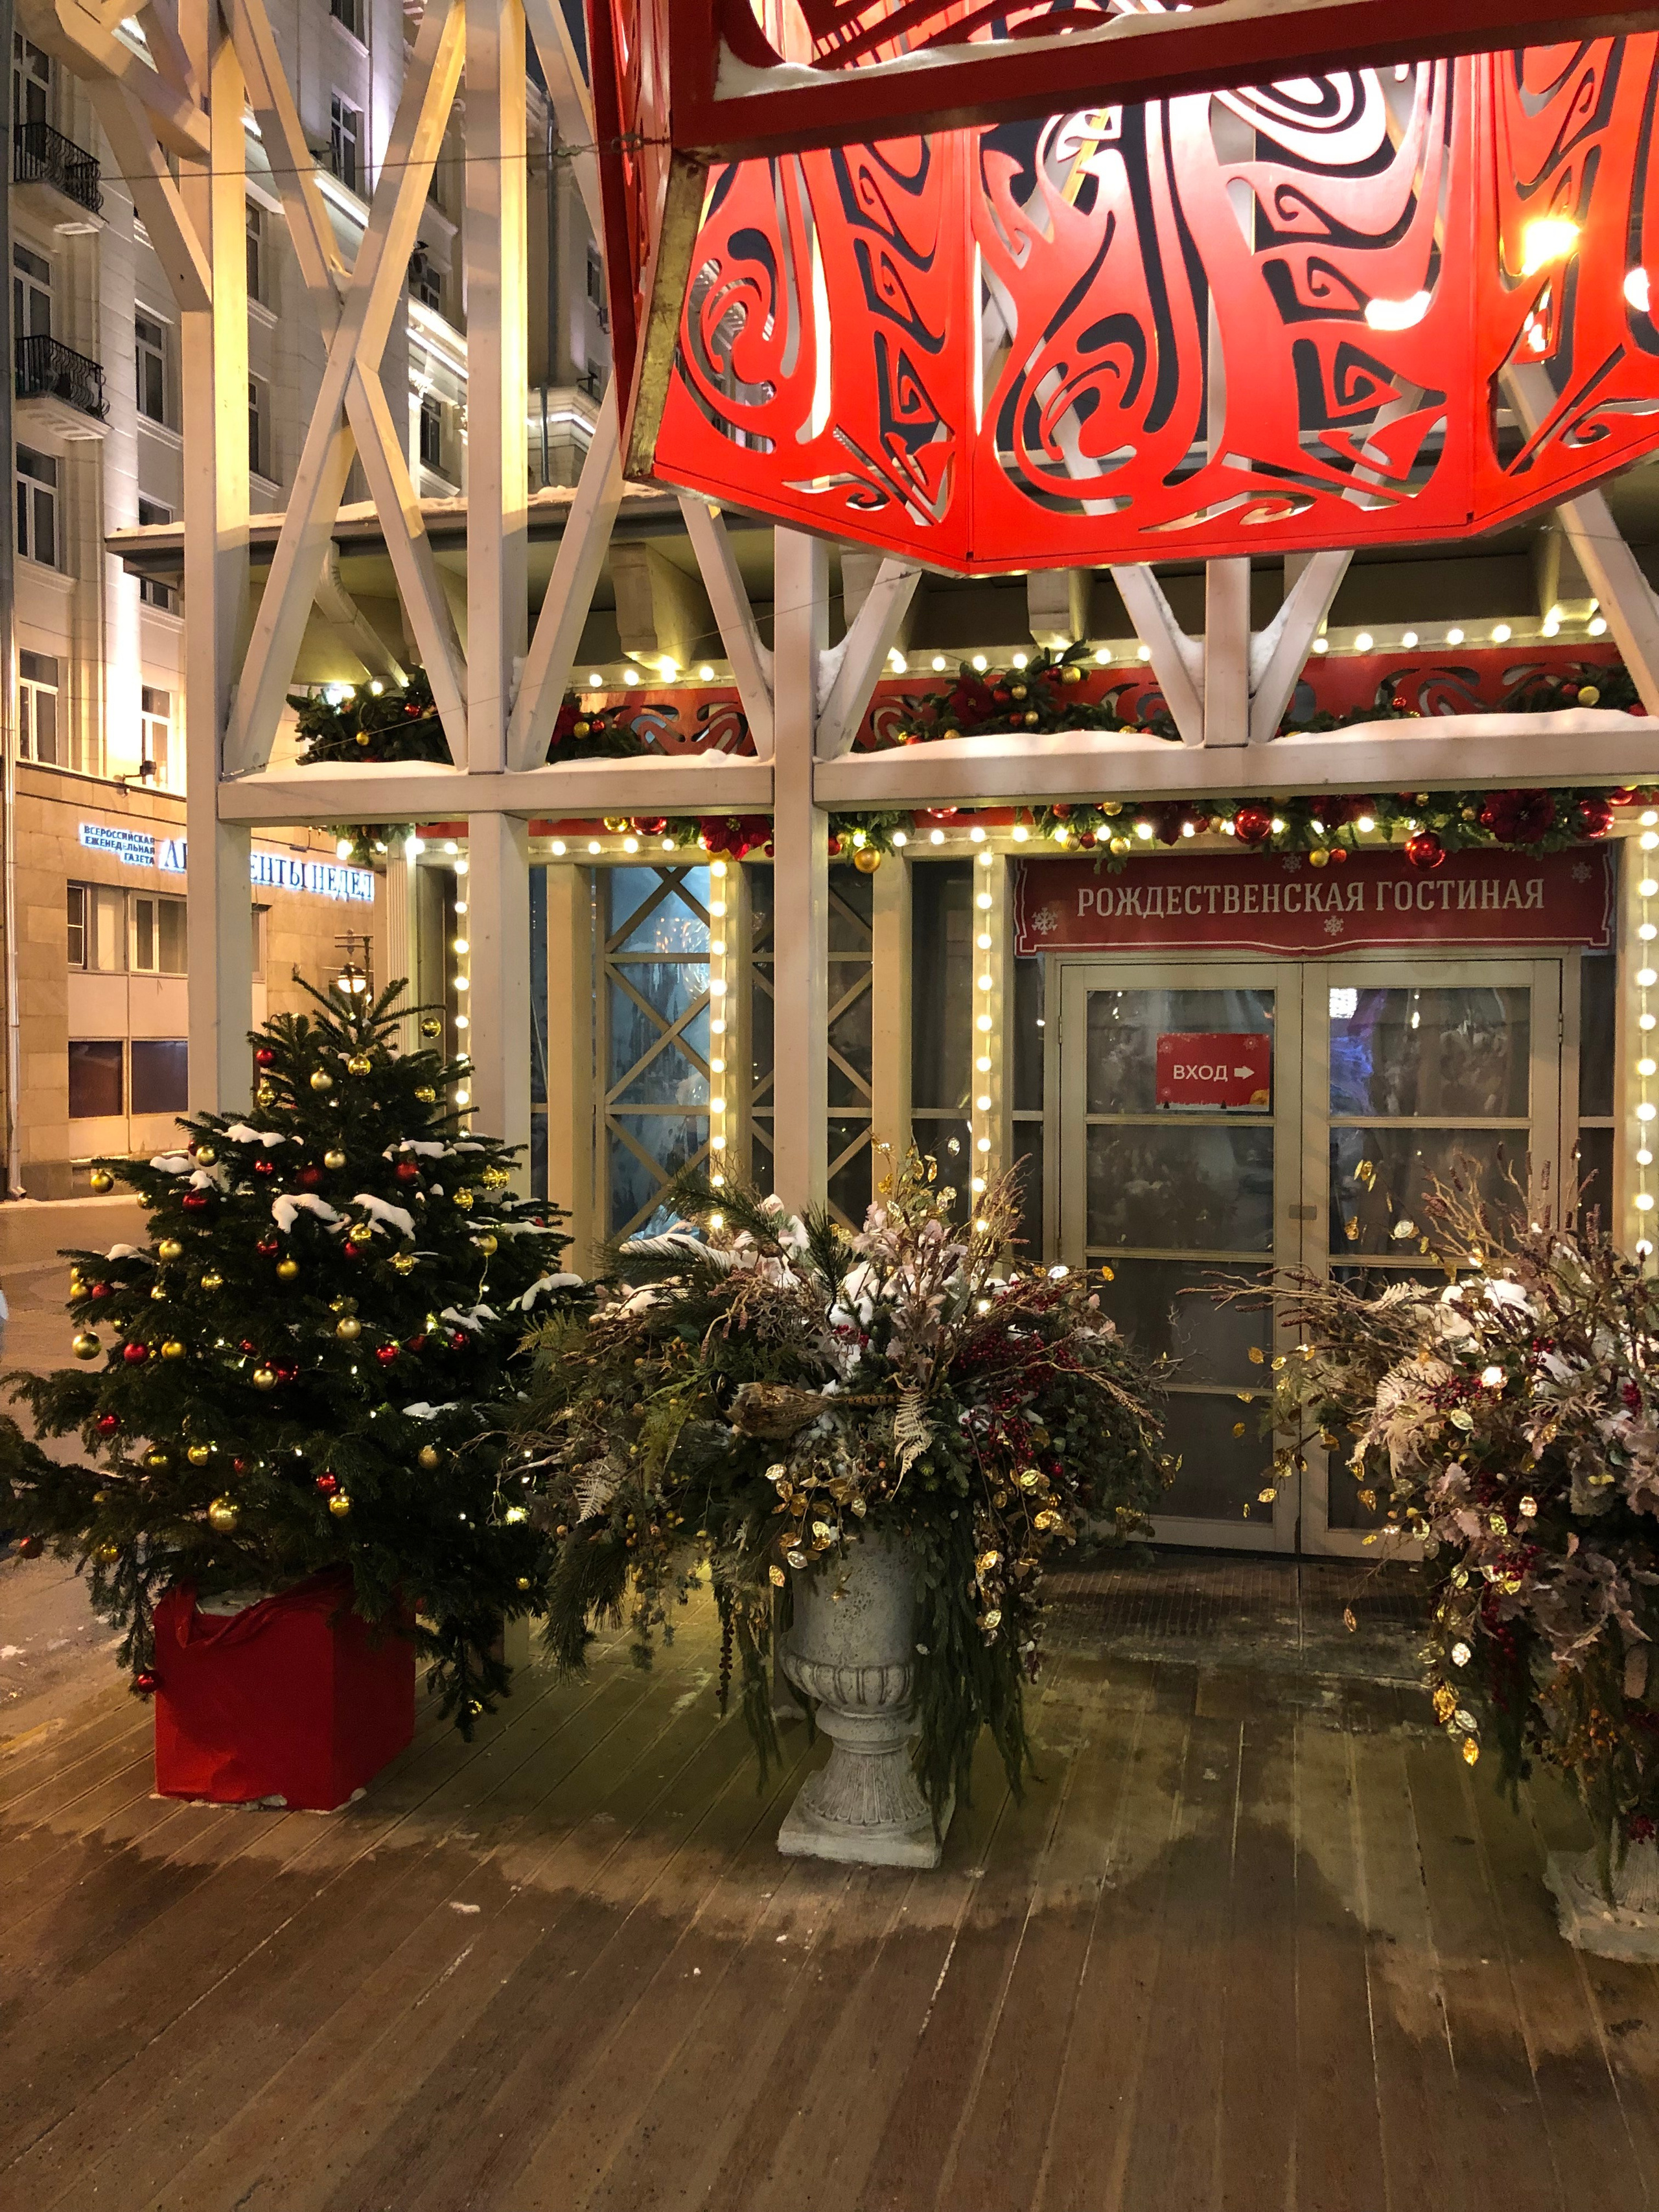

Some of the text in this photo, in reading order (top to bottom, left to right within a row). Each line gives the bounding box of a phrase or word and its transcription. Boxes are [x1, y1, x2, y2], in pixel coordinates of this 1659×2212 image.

[84, 825, 156, 844] ВСЕРОССИЙСКАЯ
[85, 836, 156, 854] ЕЖЕНЕДЕЛЬНАЯ
[124, 852, 155, 865] ГАЗЕТА
[312, 865, 373, 898] НЕДЕЛ
[1076, 878, 1545, 919] РОЖДЕСТВЕНСКАЯ ГОСТИНАЯ
[1172, 1065, 1229, 1082] ВХОД
